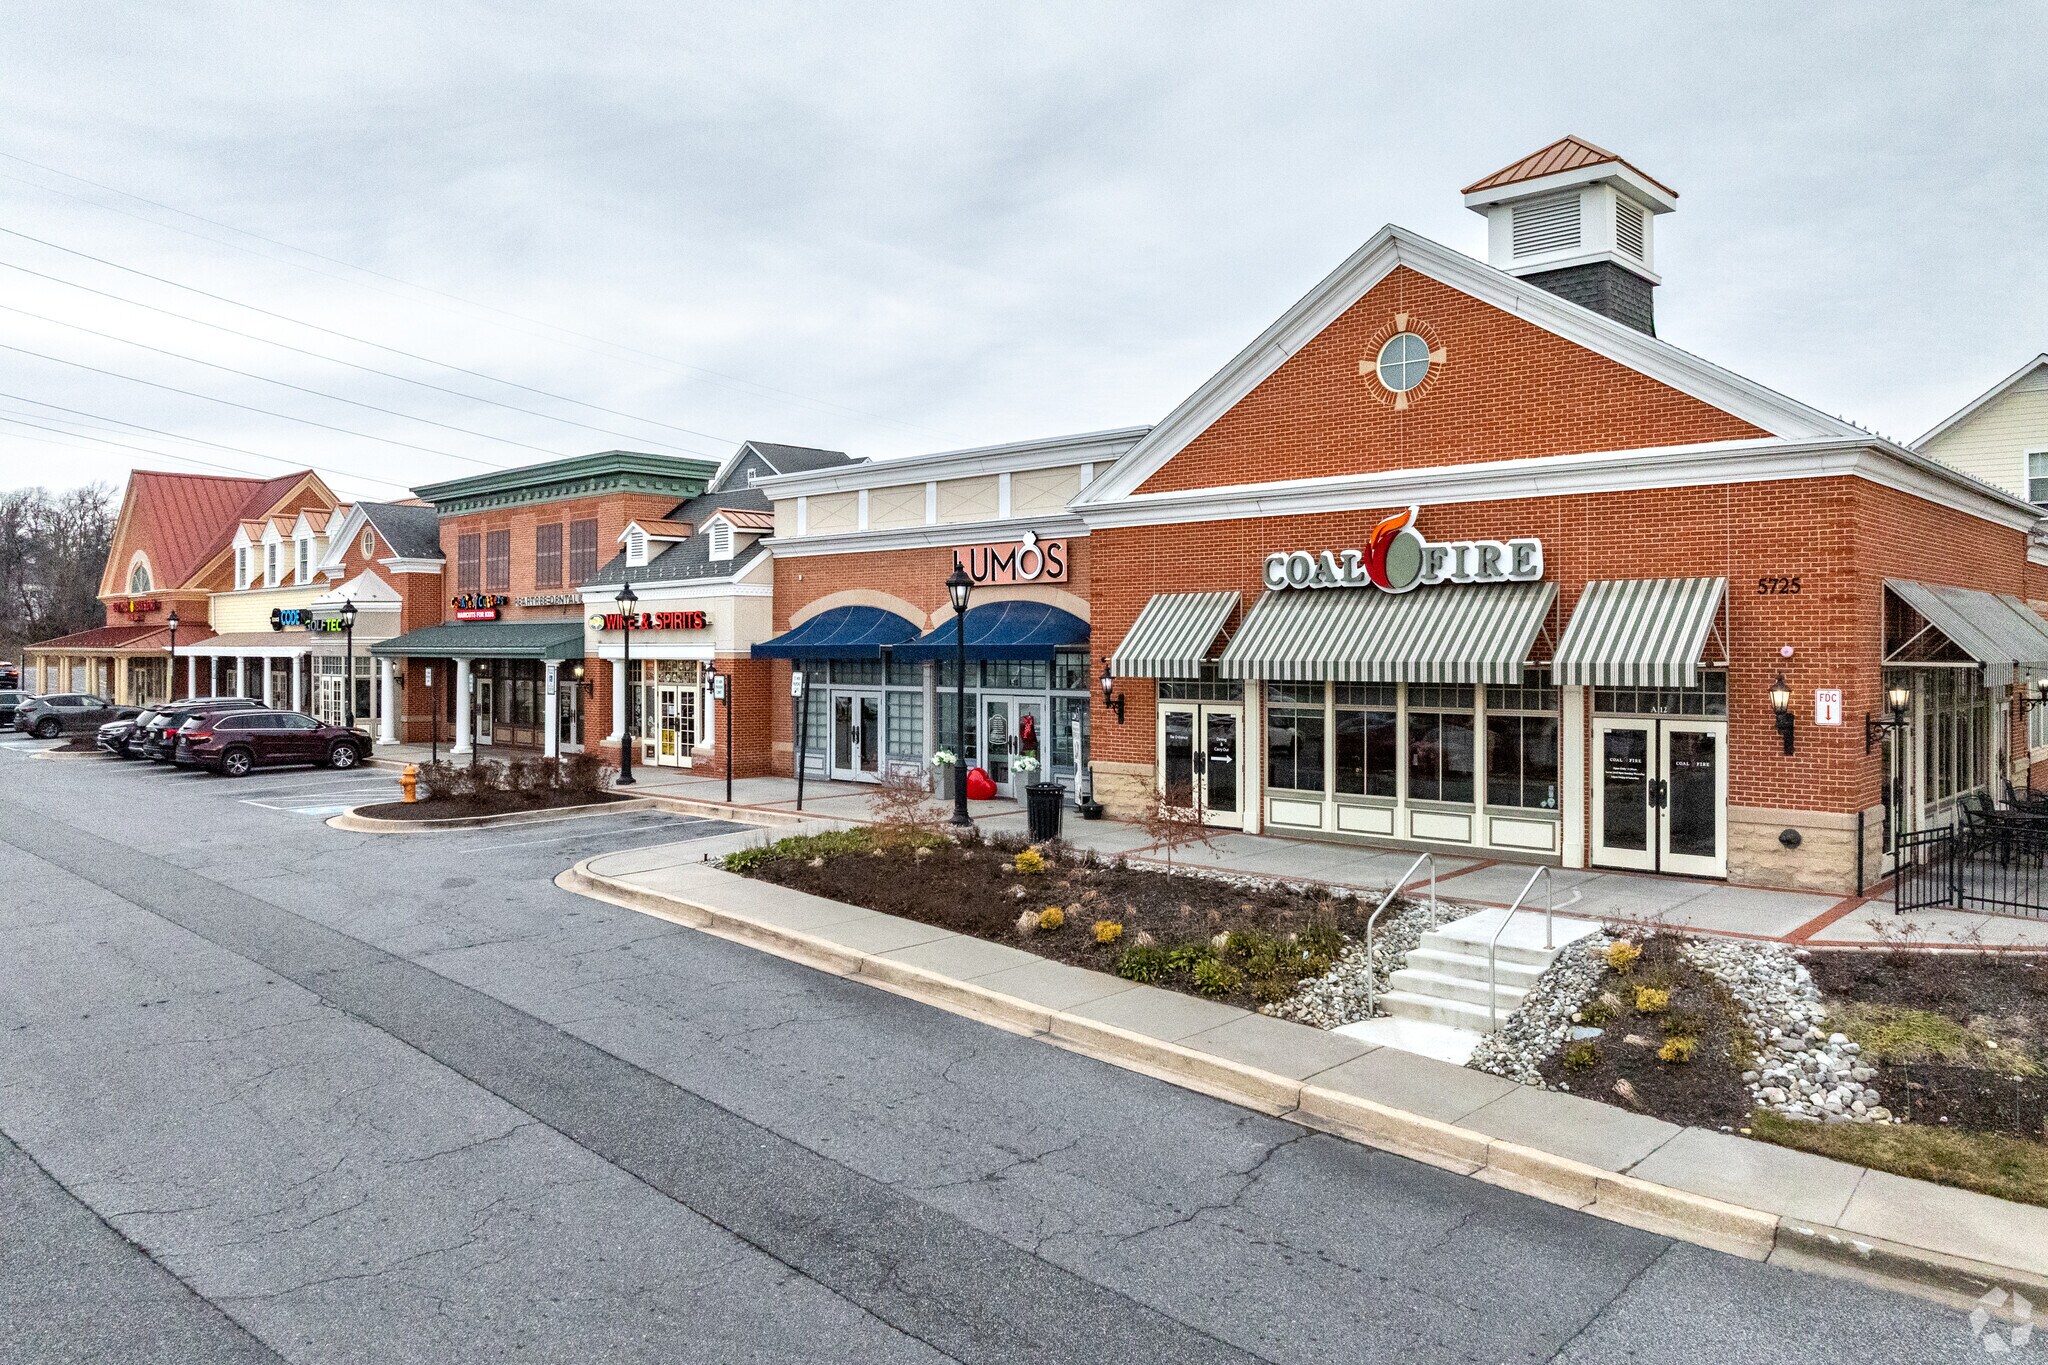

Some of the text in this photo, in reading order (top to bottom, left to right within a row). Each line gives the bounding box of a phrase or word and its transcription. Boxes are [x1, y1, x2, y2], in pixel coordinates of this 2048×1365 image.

[1262, 542, 1538, 586] COAL FIRE
[1757, 577, 1801, 594] 5725
[550, 595, 577, 605] DENTAL
[281, 609, 300, 625] CODE
[305, 619, 342, 631] GOLFTEC
[641, 613, 649, 630] &
[655, 611, 703, 630] SPIRITS
[1819, 693, 1837, 702] FDC
